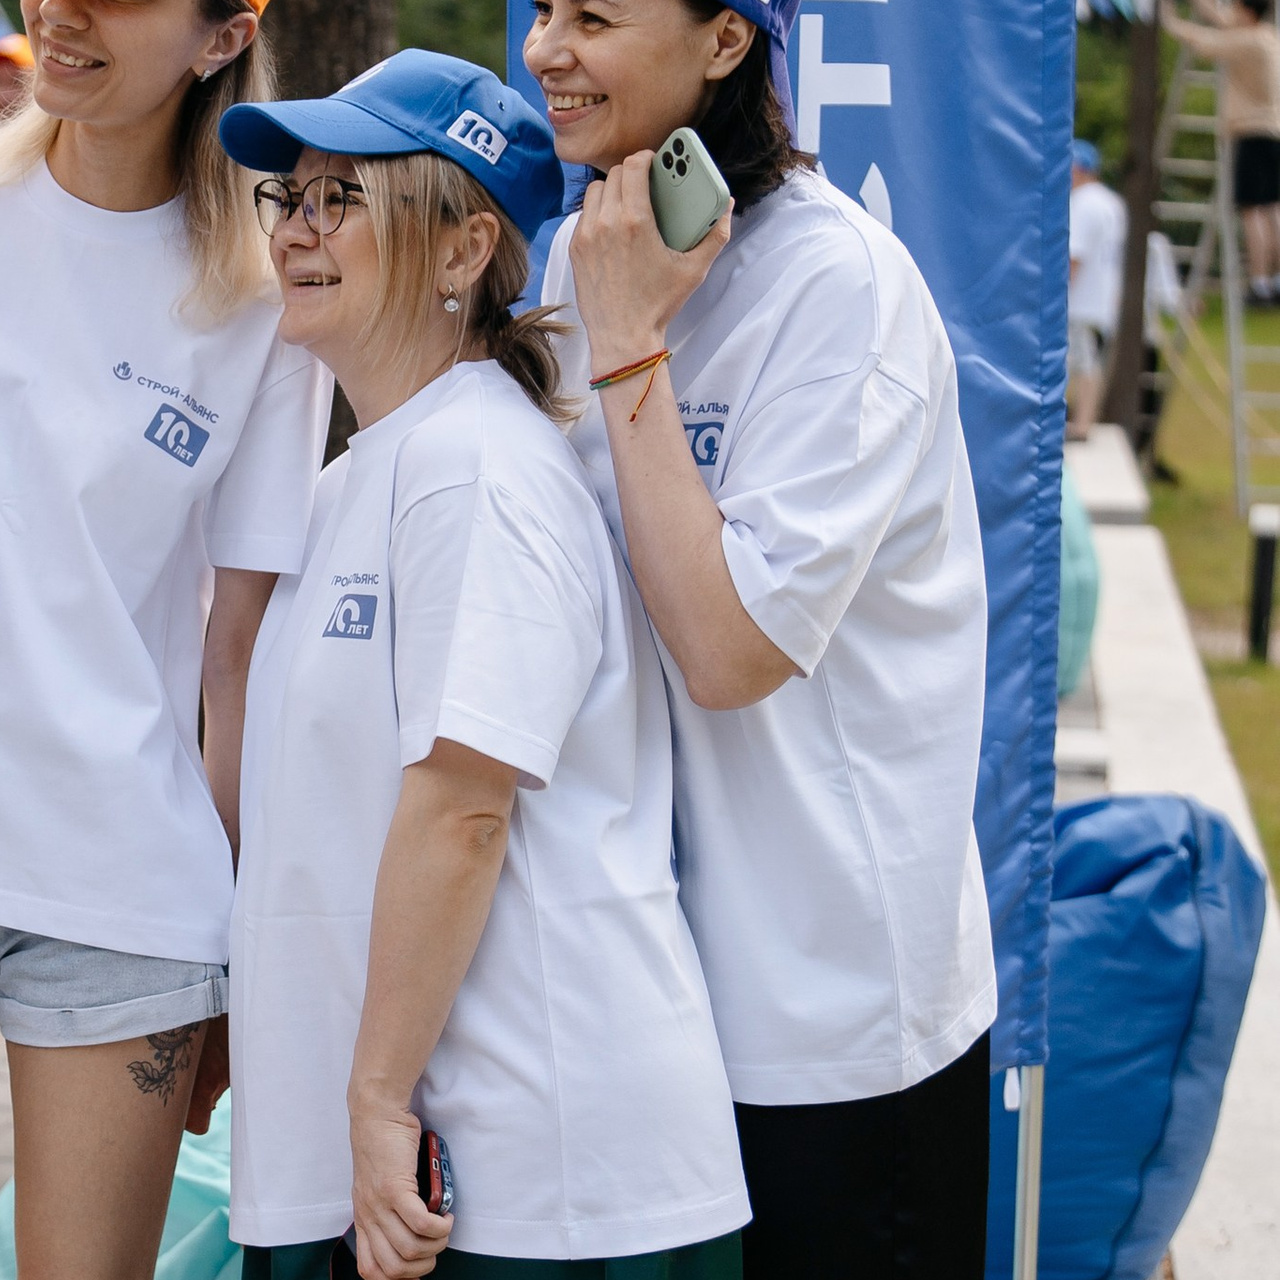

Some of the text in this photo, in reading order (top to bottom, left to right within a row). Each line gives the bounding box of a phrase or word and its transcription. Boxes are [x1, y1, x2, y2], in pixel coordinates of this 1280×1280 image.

[457, 119, 496, 158] 10 ЛЕТ
[136, 376, 220, 424] СТРОЙ-АЛЬЯНС
[153, 411, 194, 461] 10 ЛЕТ
[346, 623, 369, 635] ЛЕТ
